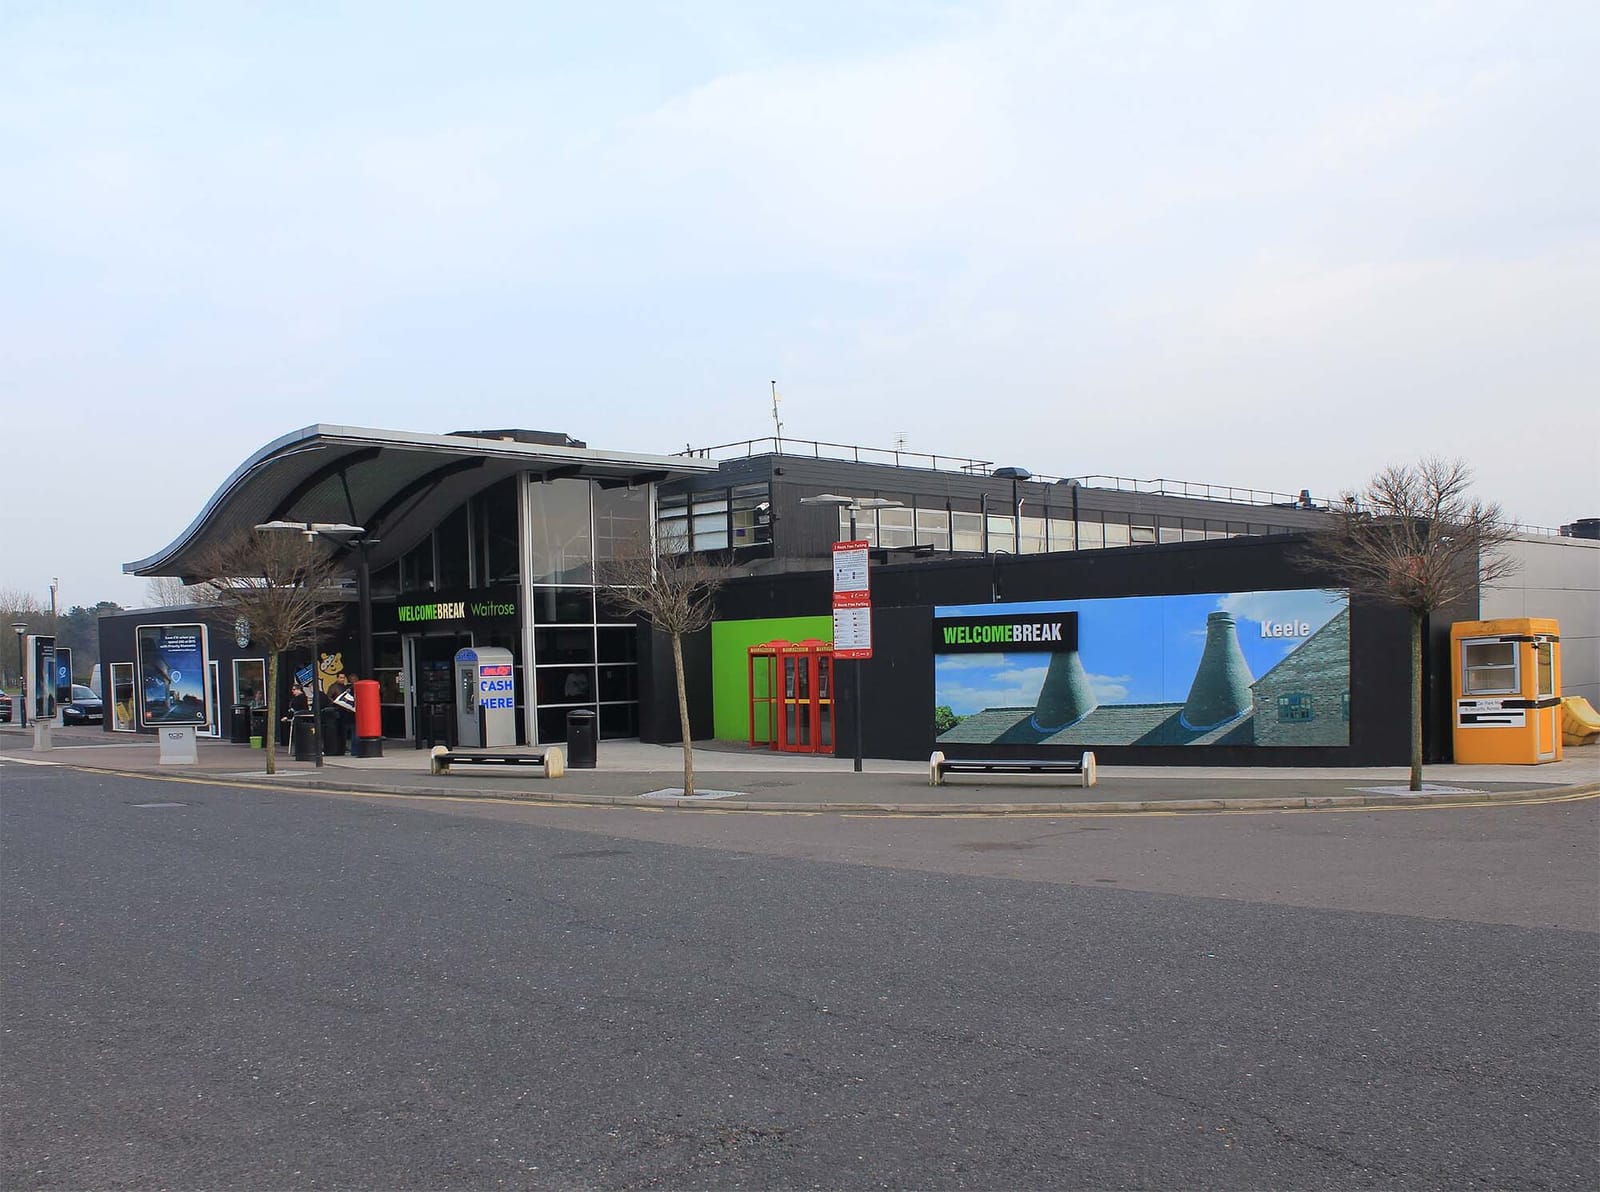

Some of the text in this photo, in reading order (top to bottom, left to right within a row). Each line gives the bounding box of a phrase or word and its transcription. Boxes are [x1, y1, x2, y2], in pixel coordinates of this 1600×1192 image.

[471, 601, 515, 616] Waitrose
[1261, 619, 1310, 638] Keele
[481, 680, 512, 692] CASH
[481, 698, 513, 709] HERE
